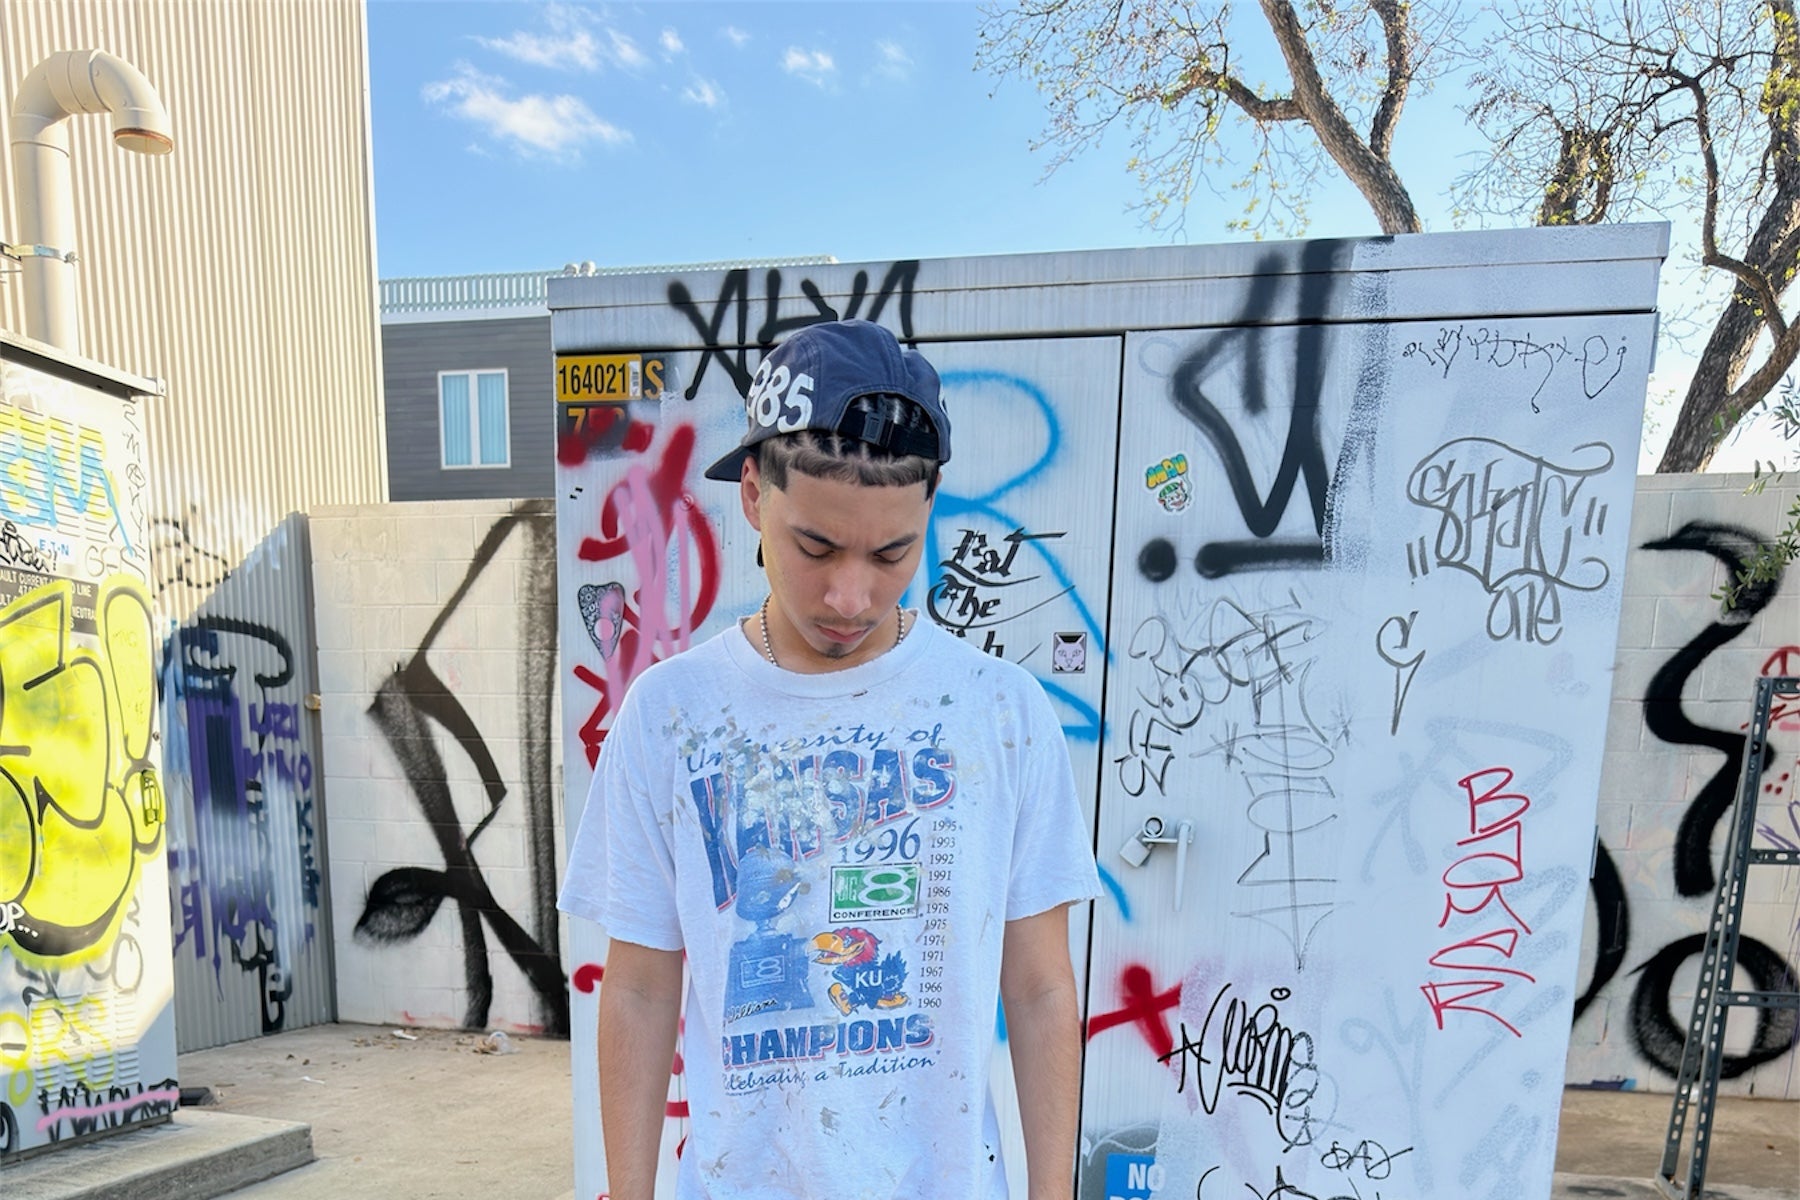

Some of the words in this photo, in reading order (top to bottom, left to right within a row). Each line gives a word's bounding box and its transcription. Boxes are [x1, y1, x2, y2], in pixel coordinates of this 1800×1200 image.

[559, 363, 627, 395] 164021
[687, 723, 889, 773] Unversity
[906, 722, 946, 749] of
[932, 820, 957, 831] 1995
[838, 816, 922, 864] 1996
[931, 837, 956, 848] 1993
[929, 854, 955, 865] 1992
[928, 870, 952, 881] 1991
[926, 887, 951, 898] 1986
[833, 908, 916, 919] CONFERENCE
[925, 903, 949, 914] 1978
[925, 919, 947, 930] 1975
[921, 951, 944, 962] 1971
[920, 967, 943, 978] 1967
[855, 970, 883, 988] KU
[919, 982, 942, 993] 1966
[917, 998, 942, 1009] 1960
[815, 1071, 829, 1081] a
[840, 1055, 935, 1077] Tradition
[1127, 1162, 1166, 1192] NO
